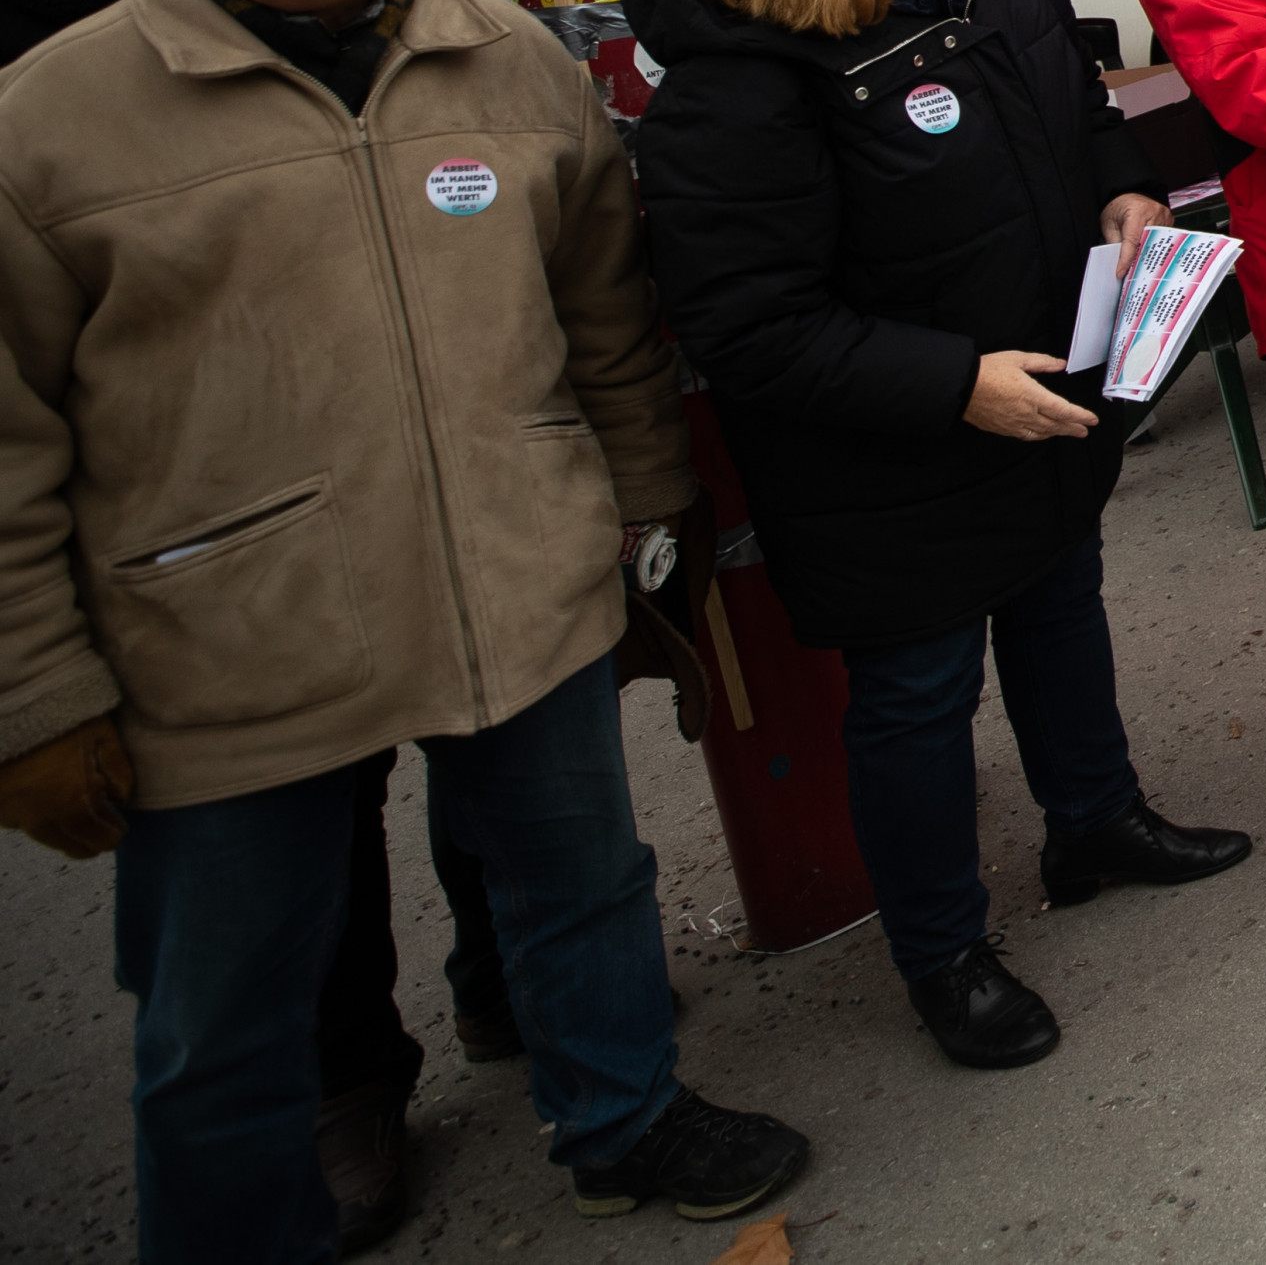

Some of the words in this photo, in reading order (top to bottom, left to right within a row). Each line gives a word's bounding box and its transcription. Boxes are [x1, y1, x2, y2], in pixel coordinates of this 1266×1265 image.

[912, 87, 941, 101] ARBEIT
[919, 94, 953, 108] HANDEL
[928, 104, 951, 115] MEHR
[923, 113, 949, 123] WERT!
[442, 164, 480, 173] ARBEIT
[430, 176, 445, 184] IM
[449, 174, 492, 182] HANDEL
[437, 186, 453, 194] IST
[457, 184, 488, 193] MEHR
[446, 193, 480, 202] WERT!
